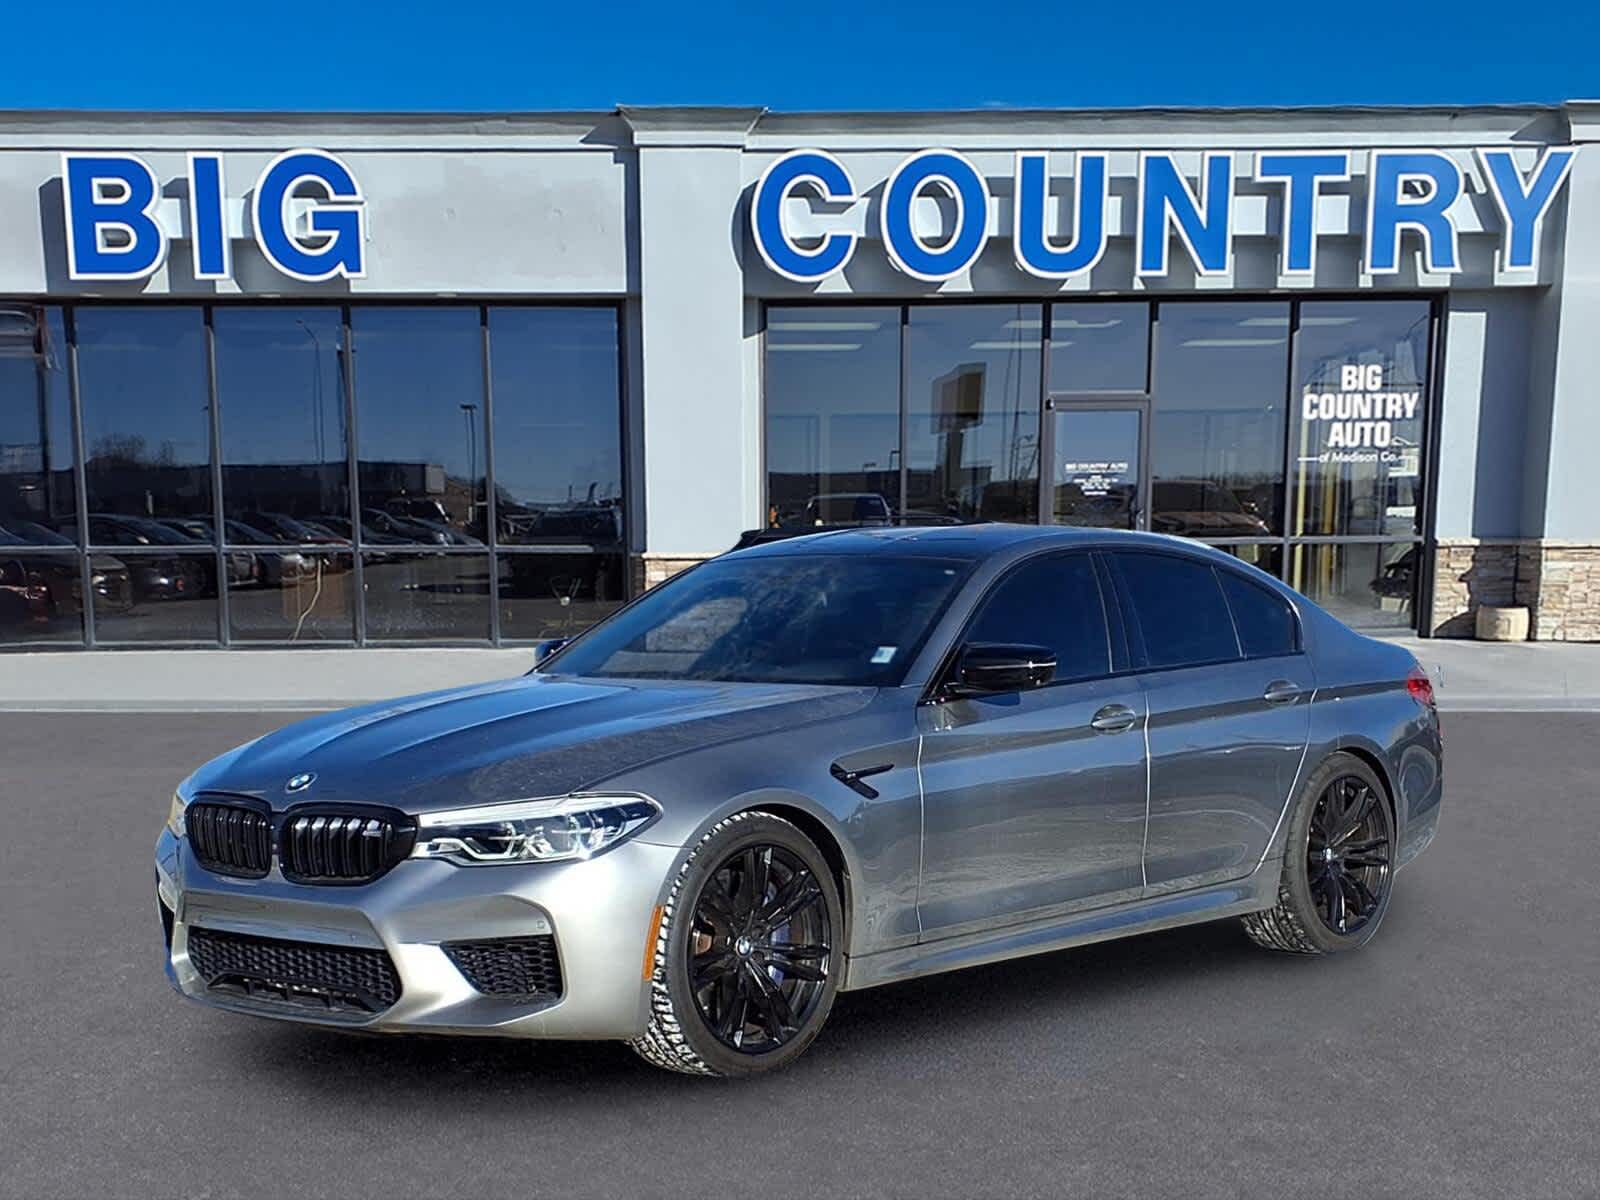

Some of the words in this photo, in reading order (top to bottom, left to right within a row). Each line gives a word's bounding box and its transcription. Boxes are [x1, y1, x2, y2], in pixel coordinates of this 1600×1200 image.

[60, 148, 367, 281] BIG
[751, 148, 1577, 283] COUNTRY
[1341, 364, 1383, 391] BIG
[1303, 393, 1420, 420] COUNTRY
[1327, 421, 1391, 447] AUTO
[1319, 453, 1330, 463] of
[1331, 452, 1378, 462] Madison
